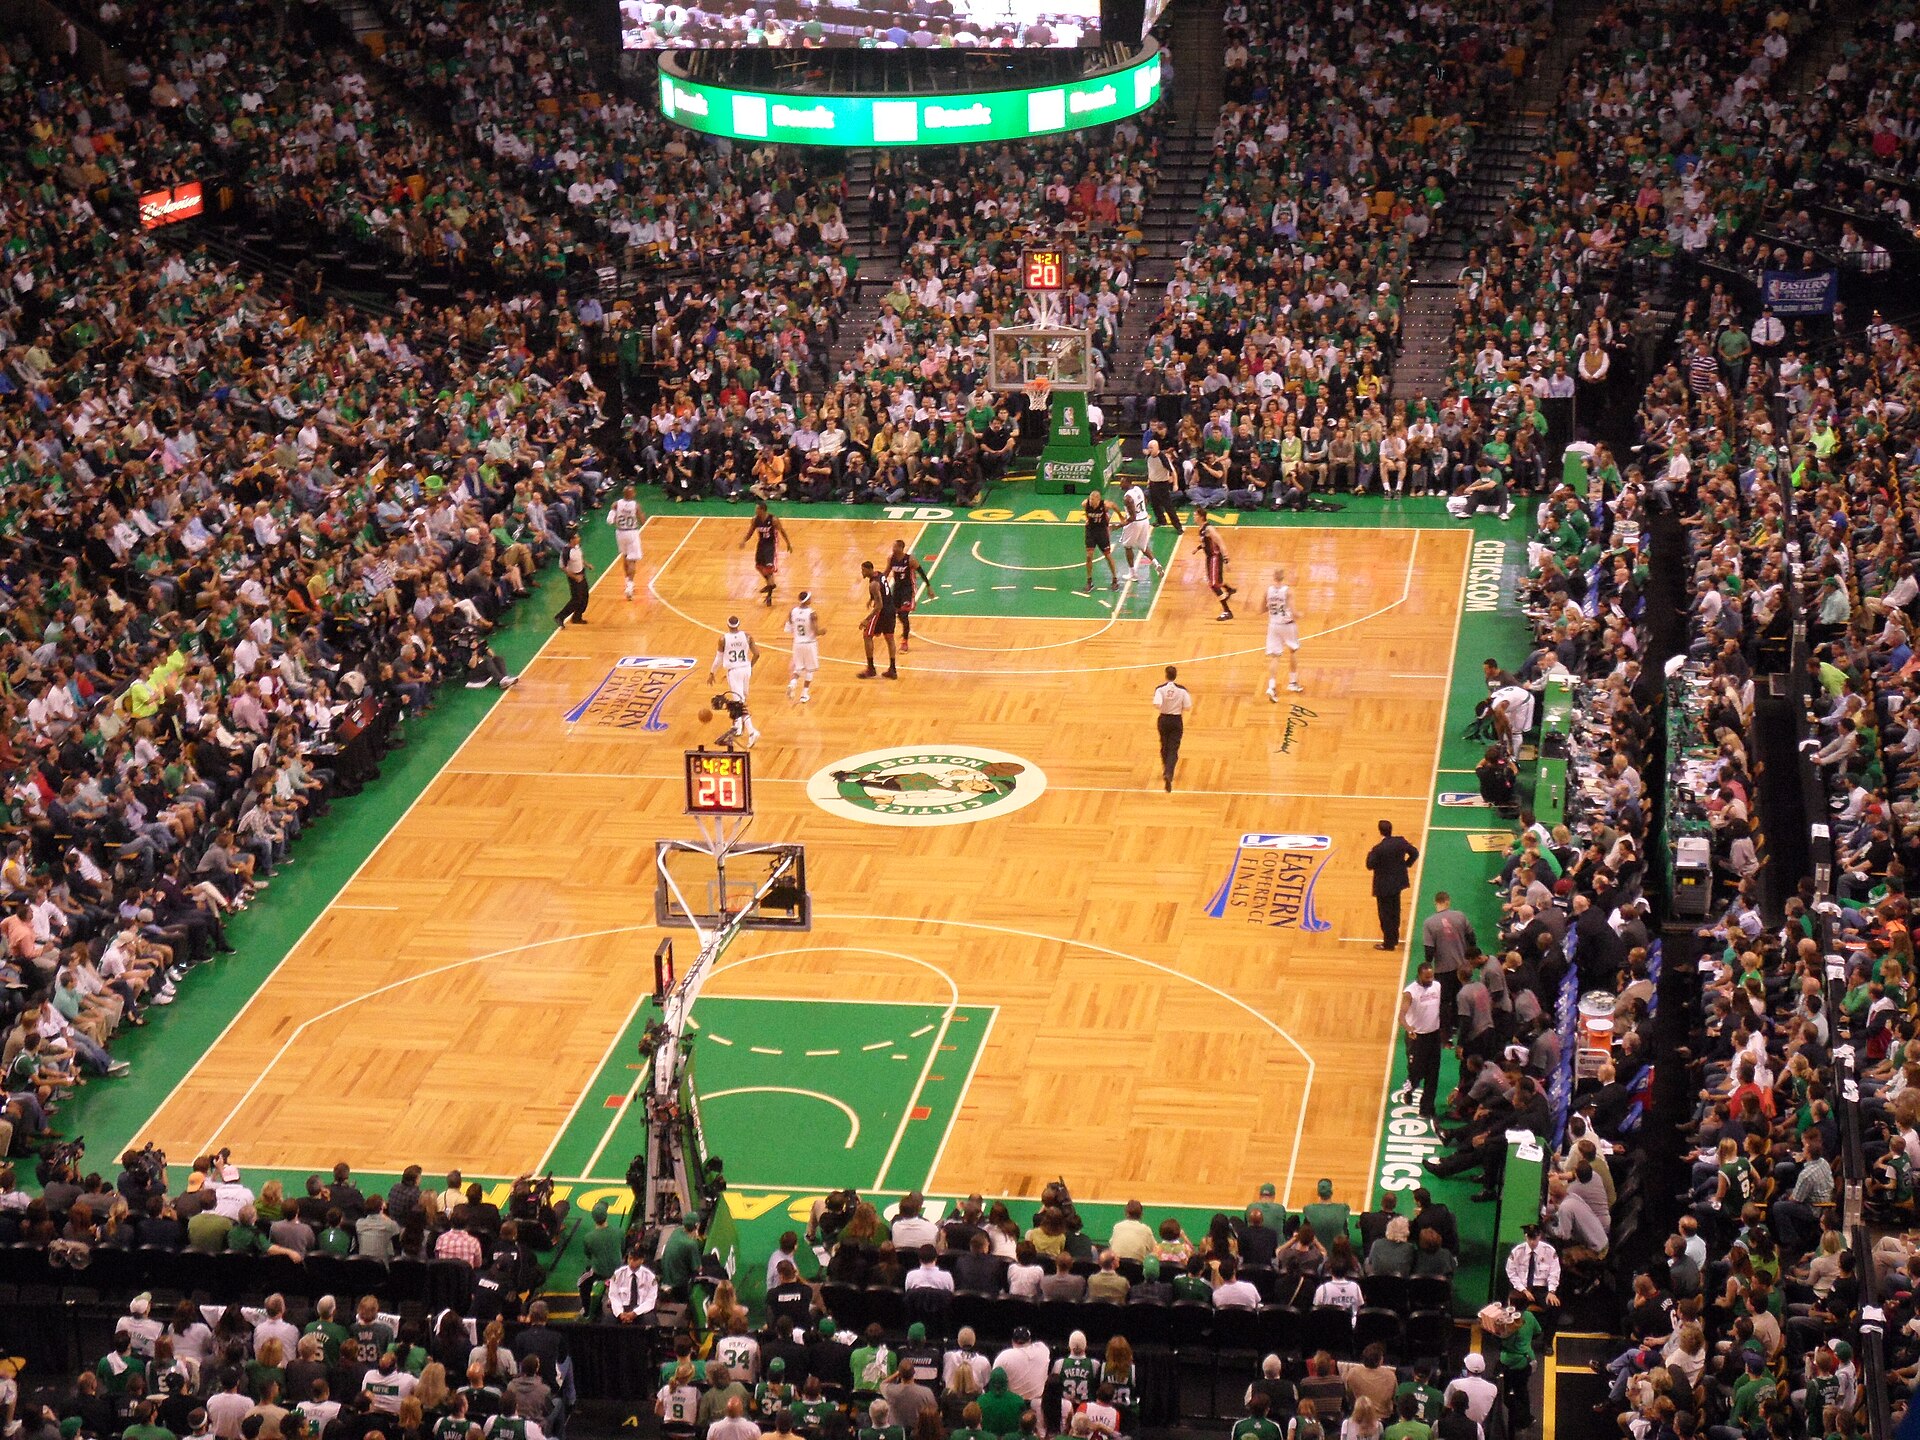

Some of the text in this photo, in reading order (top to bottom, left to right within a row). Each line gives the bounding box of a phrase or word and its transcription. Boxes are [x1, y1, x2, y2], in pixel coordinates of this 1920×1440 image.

[1033, 253, 1060, 264] 4:21
[1030, 265, 1056, 286] 20
[1780, 280, 1829, 290] EASTERN
[883, 507, 954, 520] TD
[1465, 540, 1506, 612] CELTICS.COM
[728, 649, 747, 663] 34
[588, 675, 627, 714] FINALS
[598, 669, 647, 727] CONFERENCE
[615, 671, 676, 730] EASTERN
[702, 758, 741, 776] 4:21
[876, 754, 985, 769] BOSTON
[698, 776, 737, 806] 20
[873, 799, 984, 815] CELTICS
[1230, 857, 1259, 908] FINALS
[1247, 851, 1279, 925] CONFERENCE
[1267, 852, 1314, 930] EASTERN
[778, 1293, 801, 1302] ESPN
[356, 1343, 378, 1362] 33
[724, 1349, 750, 1370] 34
[1064, 1367, 1090, 1379] PIERCE
[1062, 1379, 1089, 1402] 34
